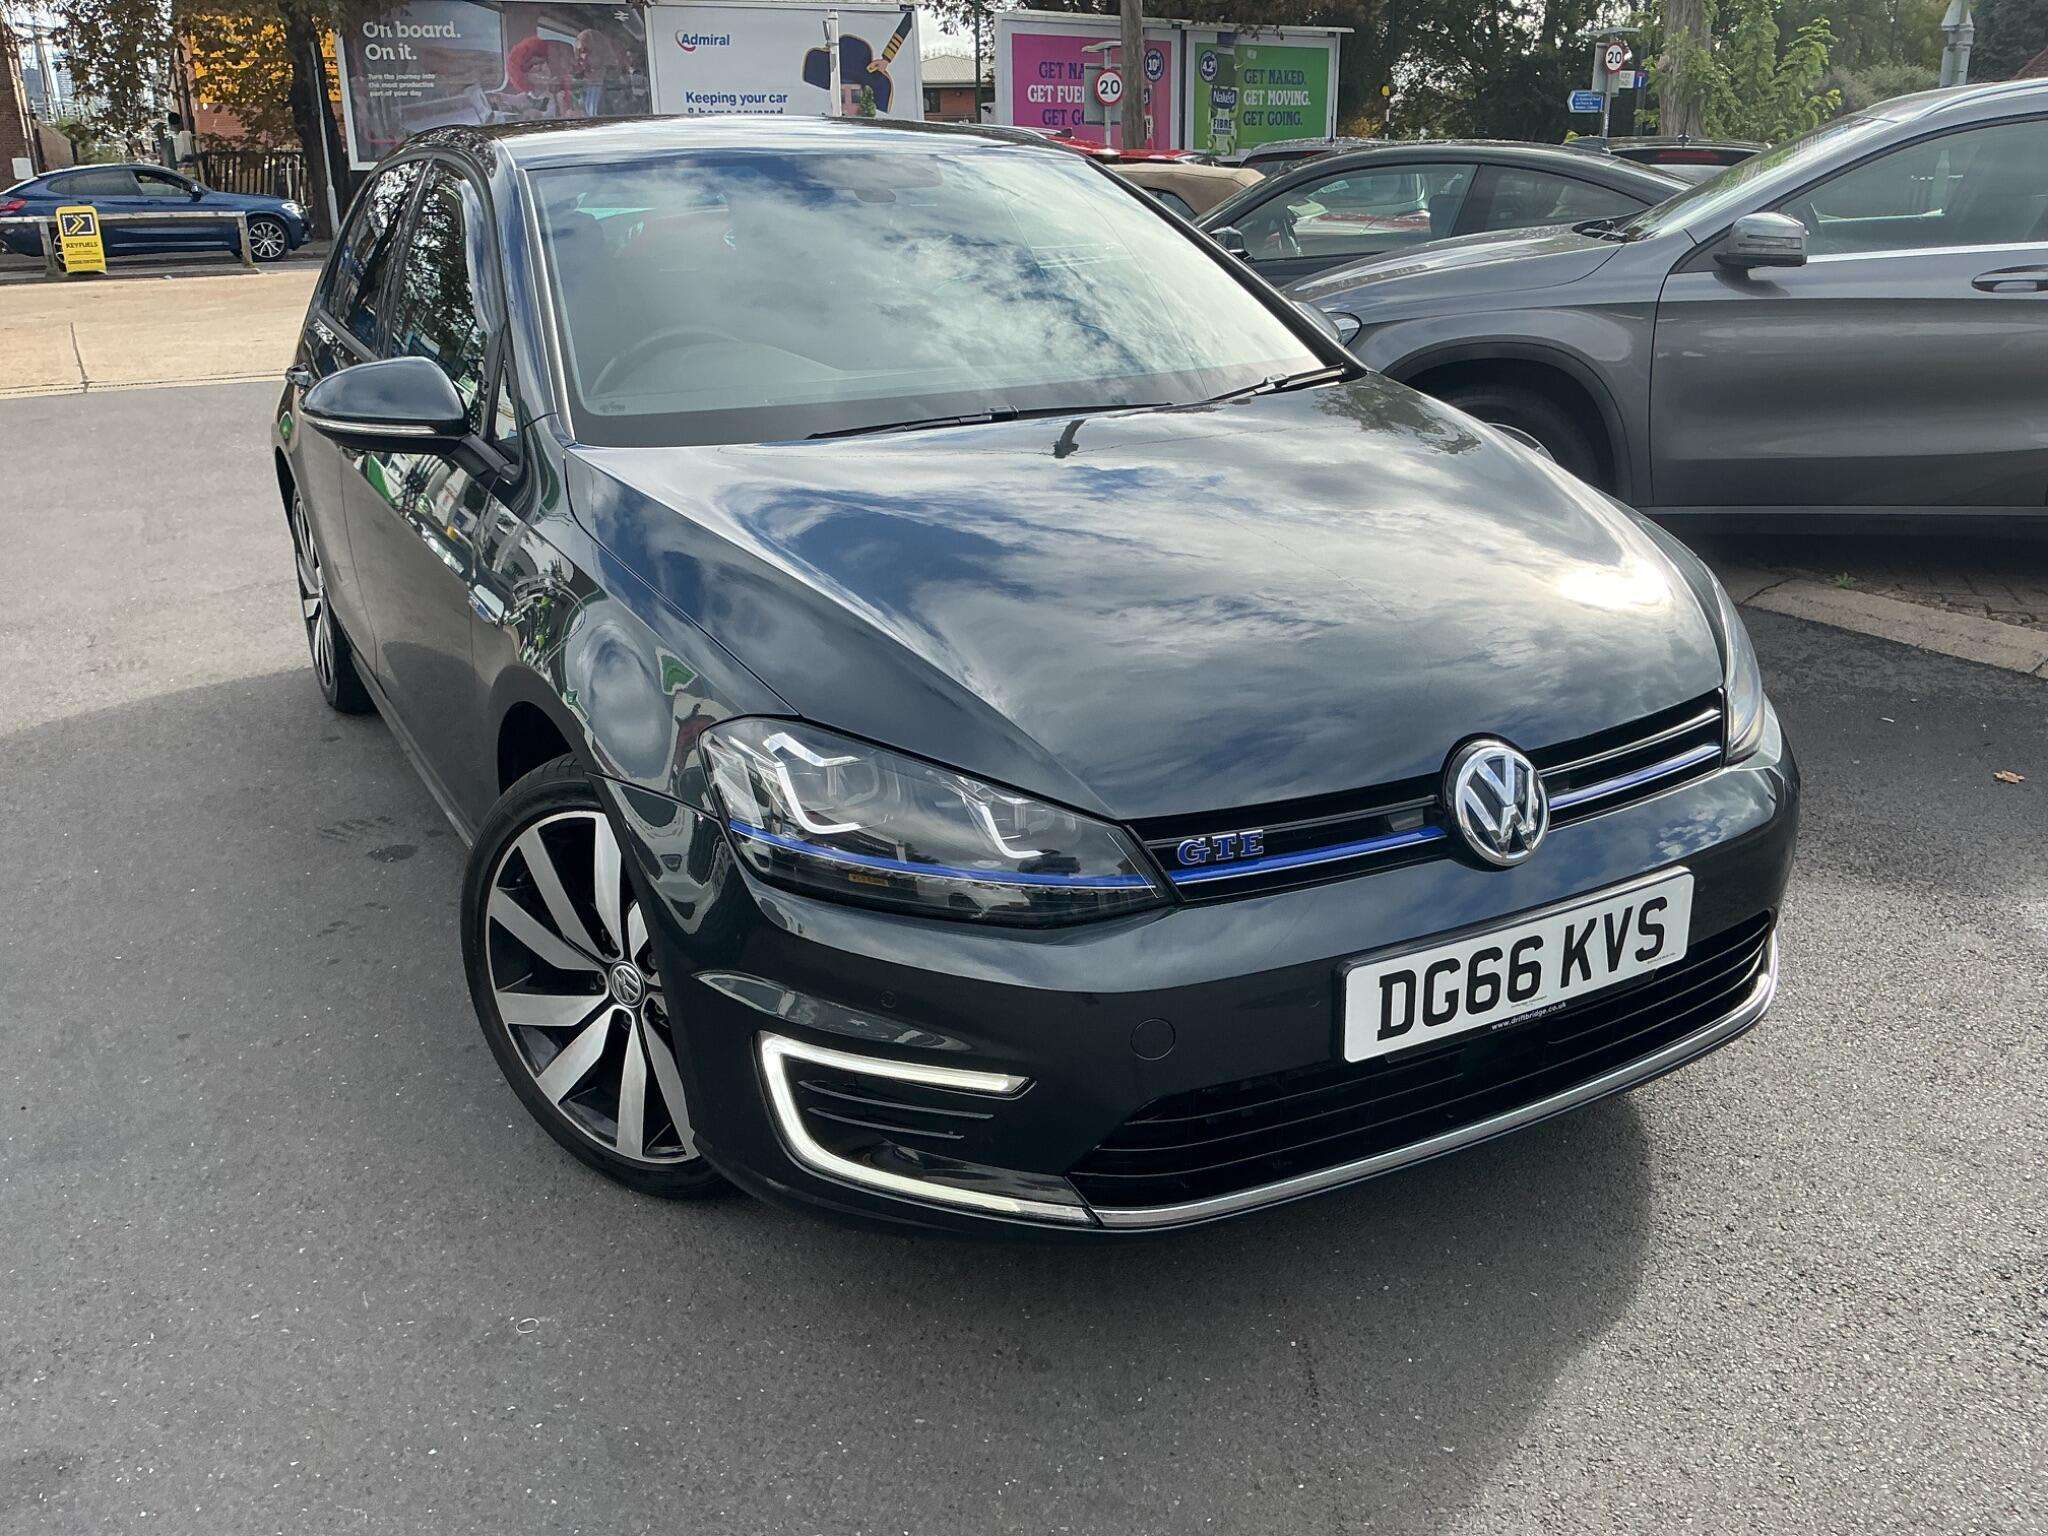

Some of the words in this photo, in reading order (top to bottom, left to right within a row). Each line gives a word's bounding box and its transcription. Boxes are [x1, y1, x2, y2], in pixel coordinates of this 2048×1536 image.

[363, 22, 393, 38] On
[396, 21, 461, 38] board.
[681, 33, 730, 46] Admiral
[365, 43, 396, 60] On
[398, 43, 418, 60] it.
[1608, 52, 1621, 64] 20
[1039, 62, 1064, 79] GET
[1244, 69, 1265, 84] GET
[1268, 69, 1307, 85] NAKED.
[1027, 84, 1054, 103] GET
[1057, 85, 1084, 103] FUE
[1100, 80, 1120, 95] 20
[685, 91, 737, 106] Keeping
[740, 94, 766, 106] your
[769, 94, 788, 103] car
[1213, 90, 1236, 103] Naked
[1243, 90, 1265, 105] GET
[1267, 91, 1311, 106] MOVING.
[1042, 109, 1067, 126] GET
[1213, 119, 1232, 129] FIBRE
[1243, 111, 1264, 126] GET
[1267, 111, 1304, 126] GOING.
[1177, 829, 1264, 865] GTE
[1377, 935, 1544, 1041] DG66
[1560, 896, 1668, 989] KVS
[1491, 1001, 1567, 1031] www.driftbridge.co.uk
